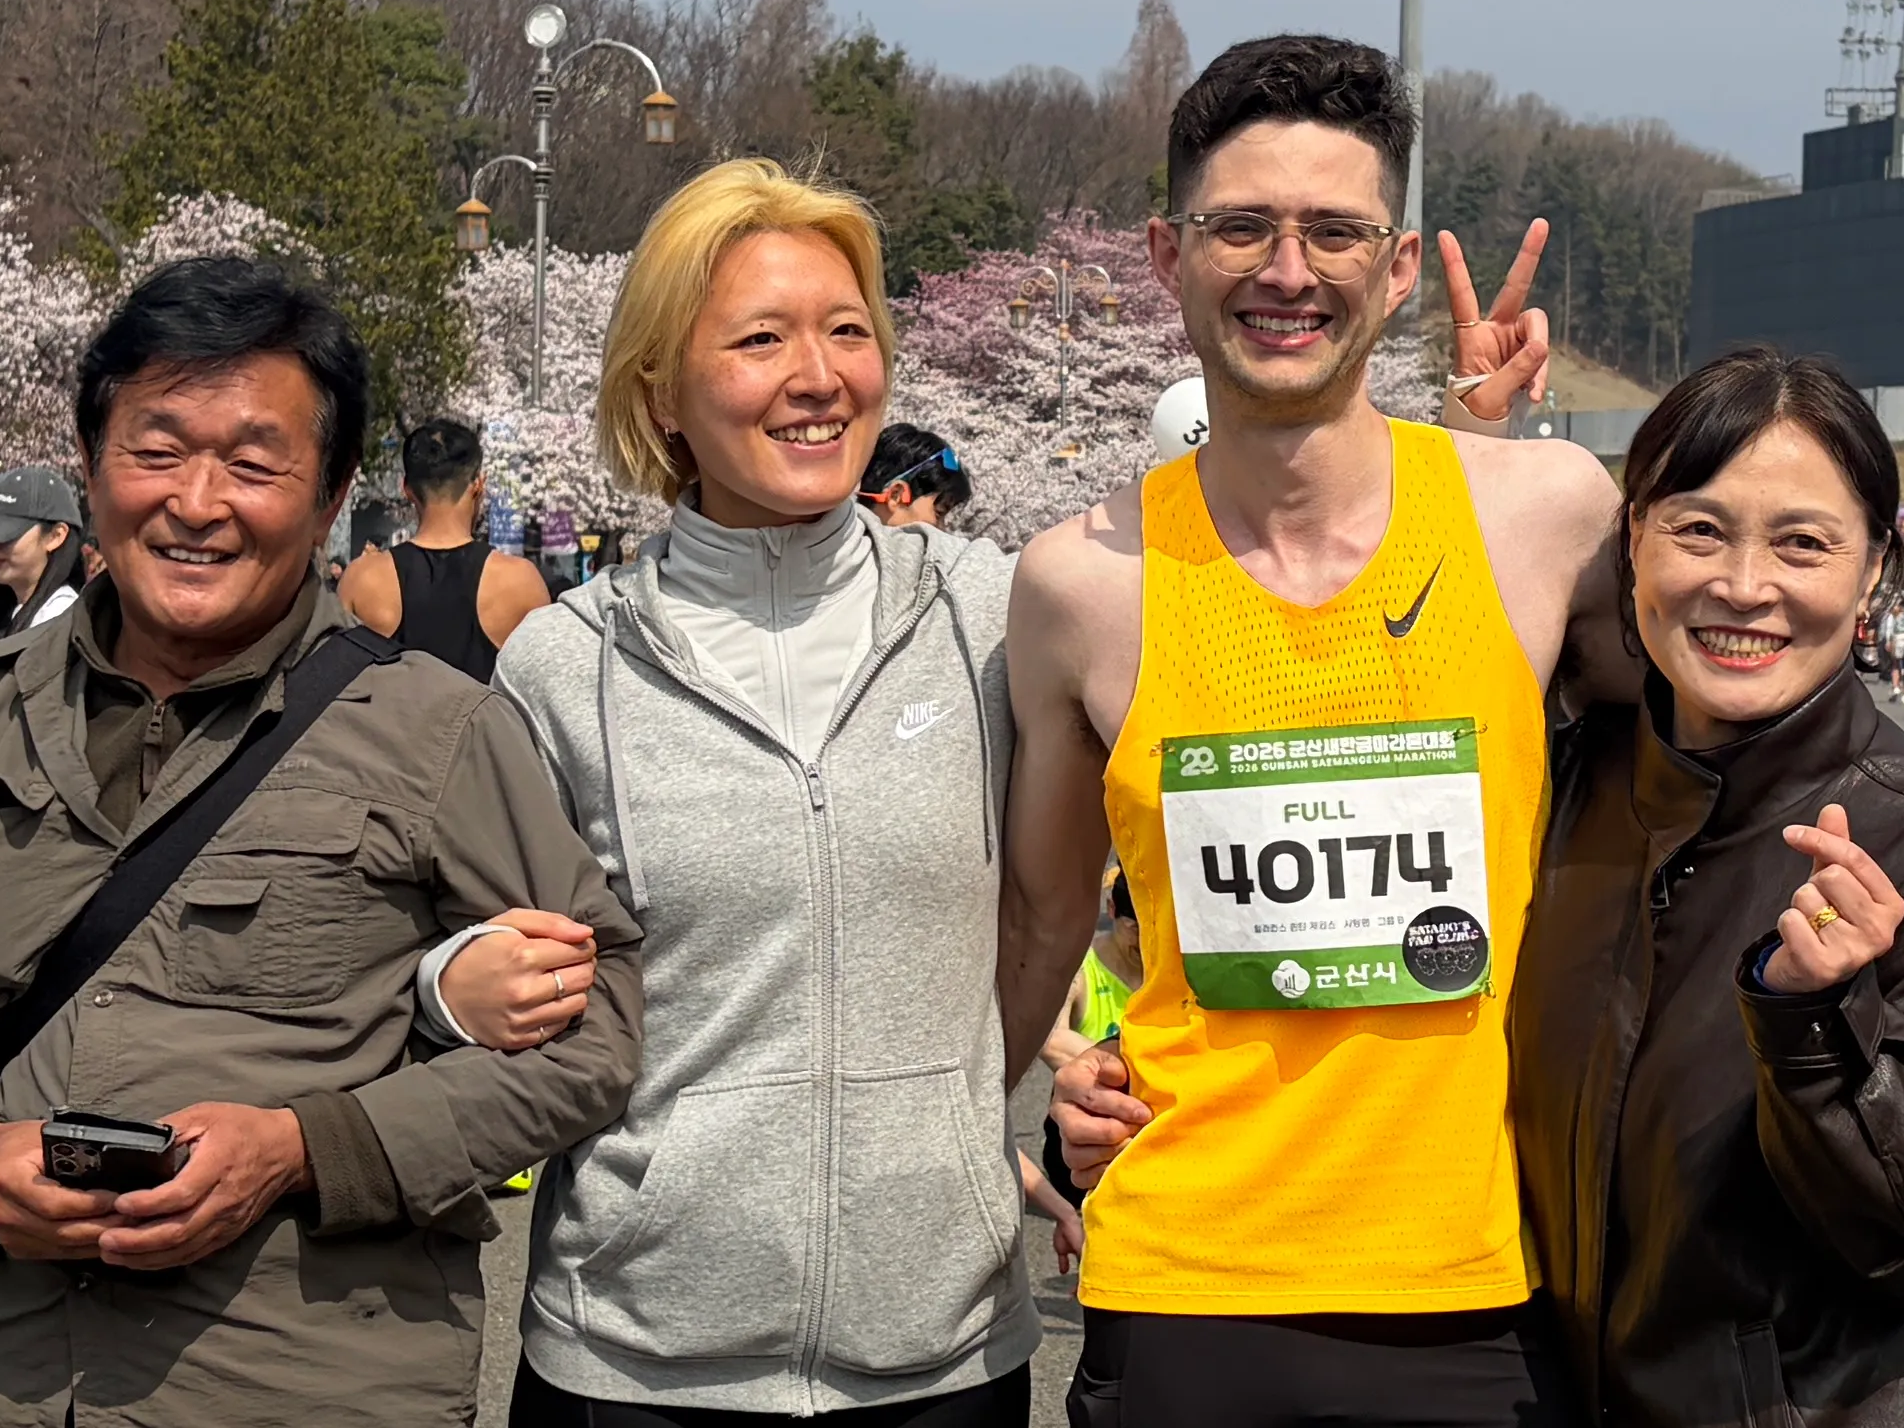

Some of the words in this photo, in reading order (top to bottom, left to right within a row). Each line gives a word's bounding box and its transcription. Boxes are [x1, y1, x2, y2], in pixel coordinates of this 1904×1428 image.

[903, 700, 940, 725] NIKE
[1229, 741, 1285, 763] 2026
[1288, 731, 1456, 759] 군산새만금마라톤대회
[1230, 763, 1258, 774] 2026
[1262, 759, 1309, 772] GUNSAN
[1394, 750, 1456, 764] MARATHON
[1283, 800, 1356, 823] FULL
[1201, 830, 1453, 905] 40174
[1314, 961, 1396, 989] 군산시
